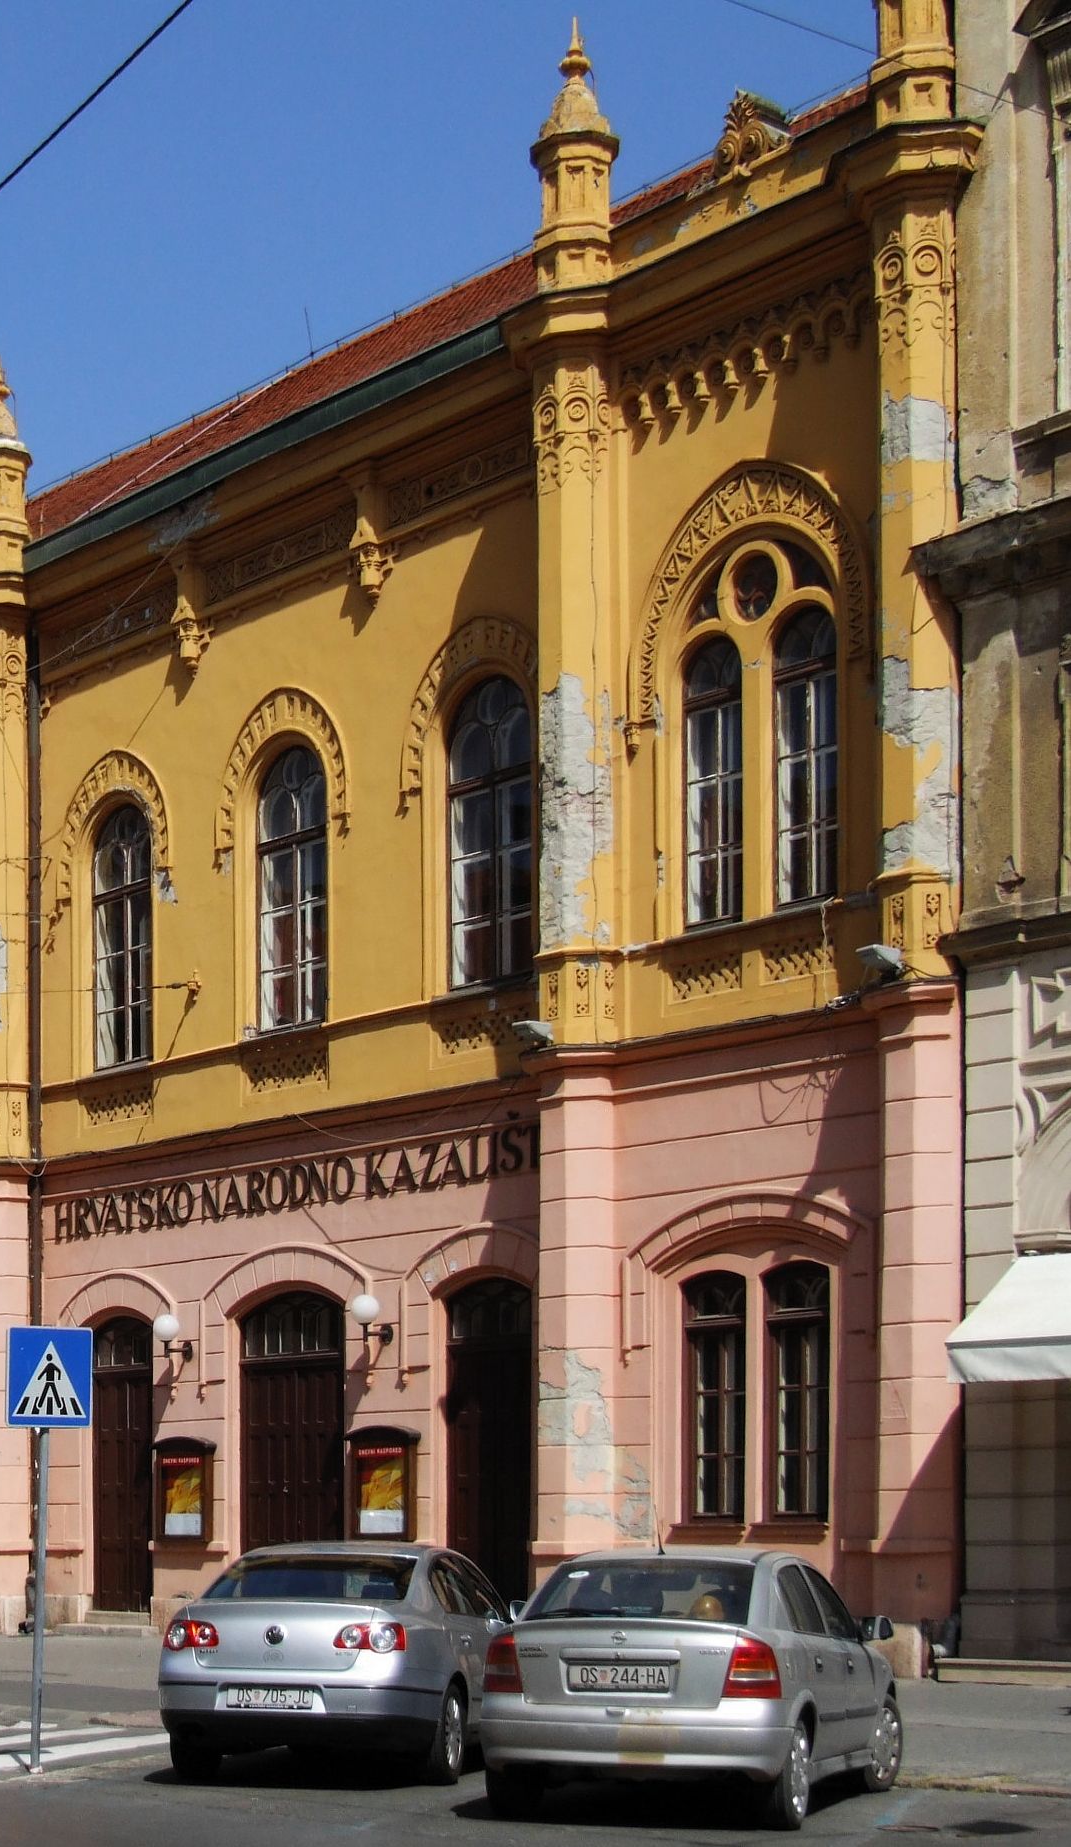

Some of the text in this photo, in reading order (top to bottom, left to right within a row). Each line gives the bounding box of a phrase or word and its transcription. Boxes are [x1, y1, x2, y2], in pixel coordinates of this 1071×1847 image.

[55, 1180, 194, 1245] HRVATSKO
[201, 1156, 355, 1225] NARODNO
[580, 1667, 666, 1684] OS 244-HA
[237, 1689, 252, 1703] OS
